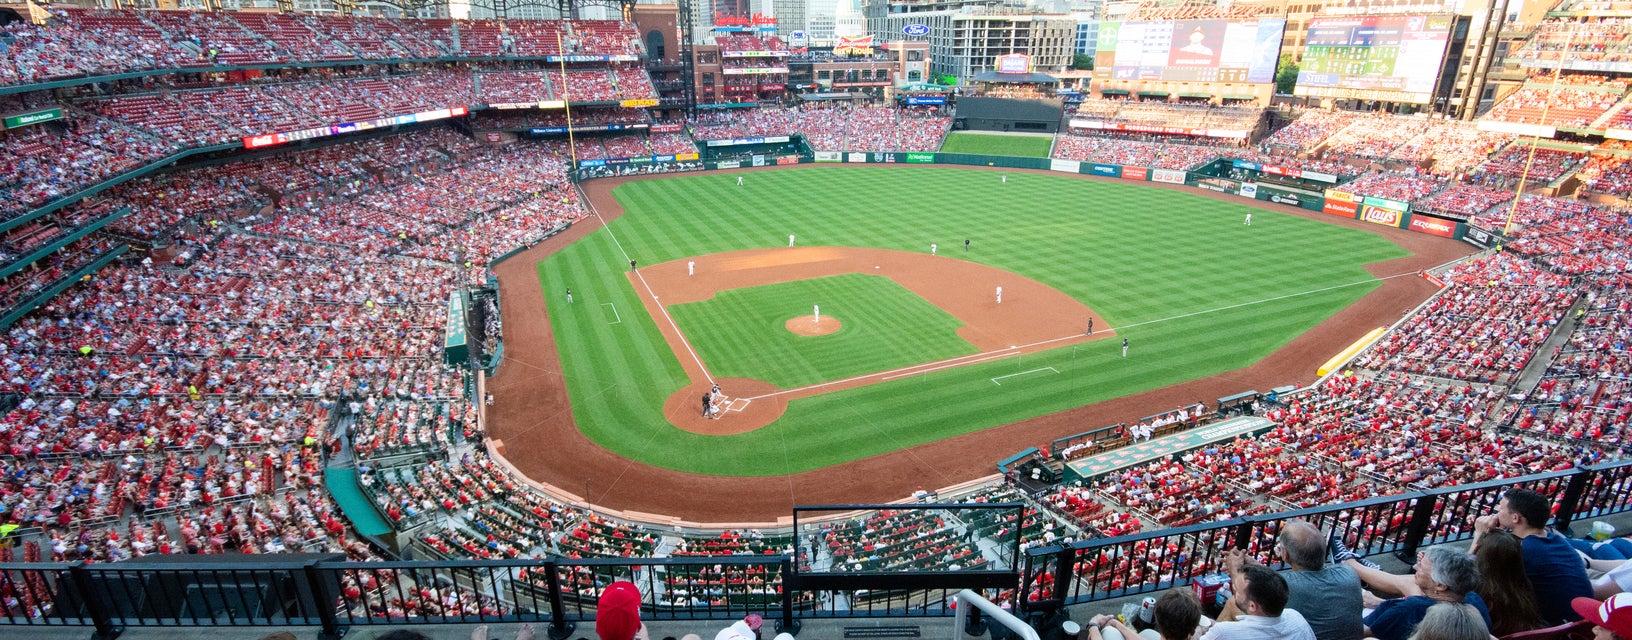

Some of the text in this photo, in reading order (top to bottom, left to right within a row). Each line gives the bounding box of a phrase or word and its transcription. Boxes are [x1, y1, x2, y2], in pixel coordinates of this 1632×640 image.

[713, 12, 777, 27] Cardinals Nation
[908, 25, 926, 34] Ford
[838, 39, 870, 47] Budweiser
[1124, 124, 1163, 133] SCOREBOARD
[1412, 219, 1451, 232] EQUIFAX
